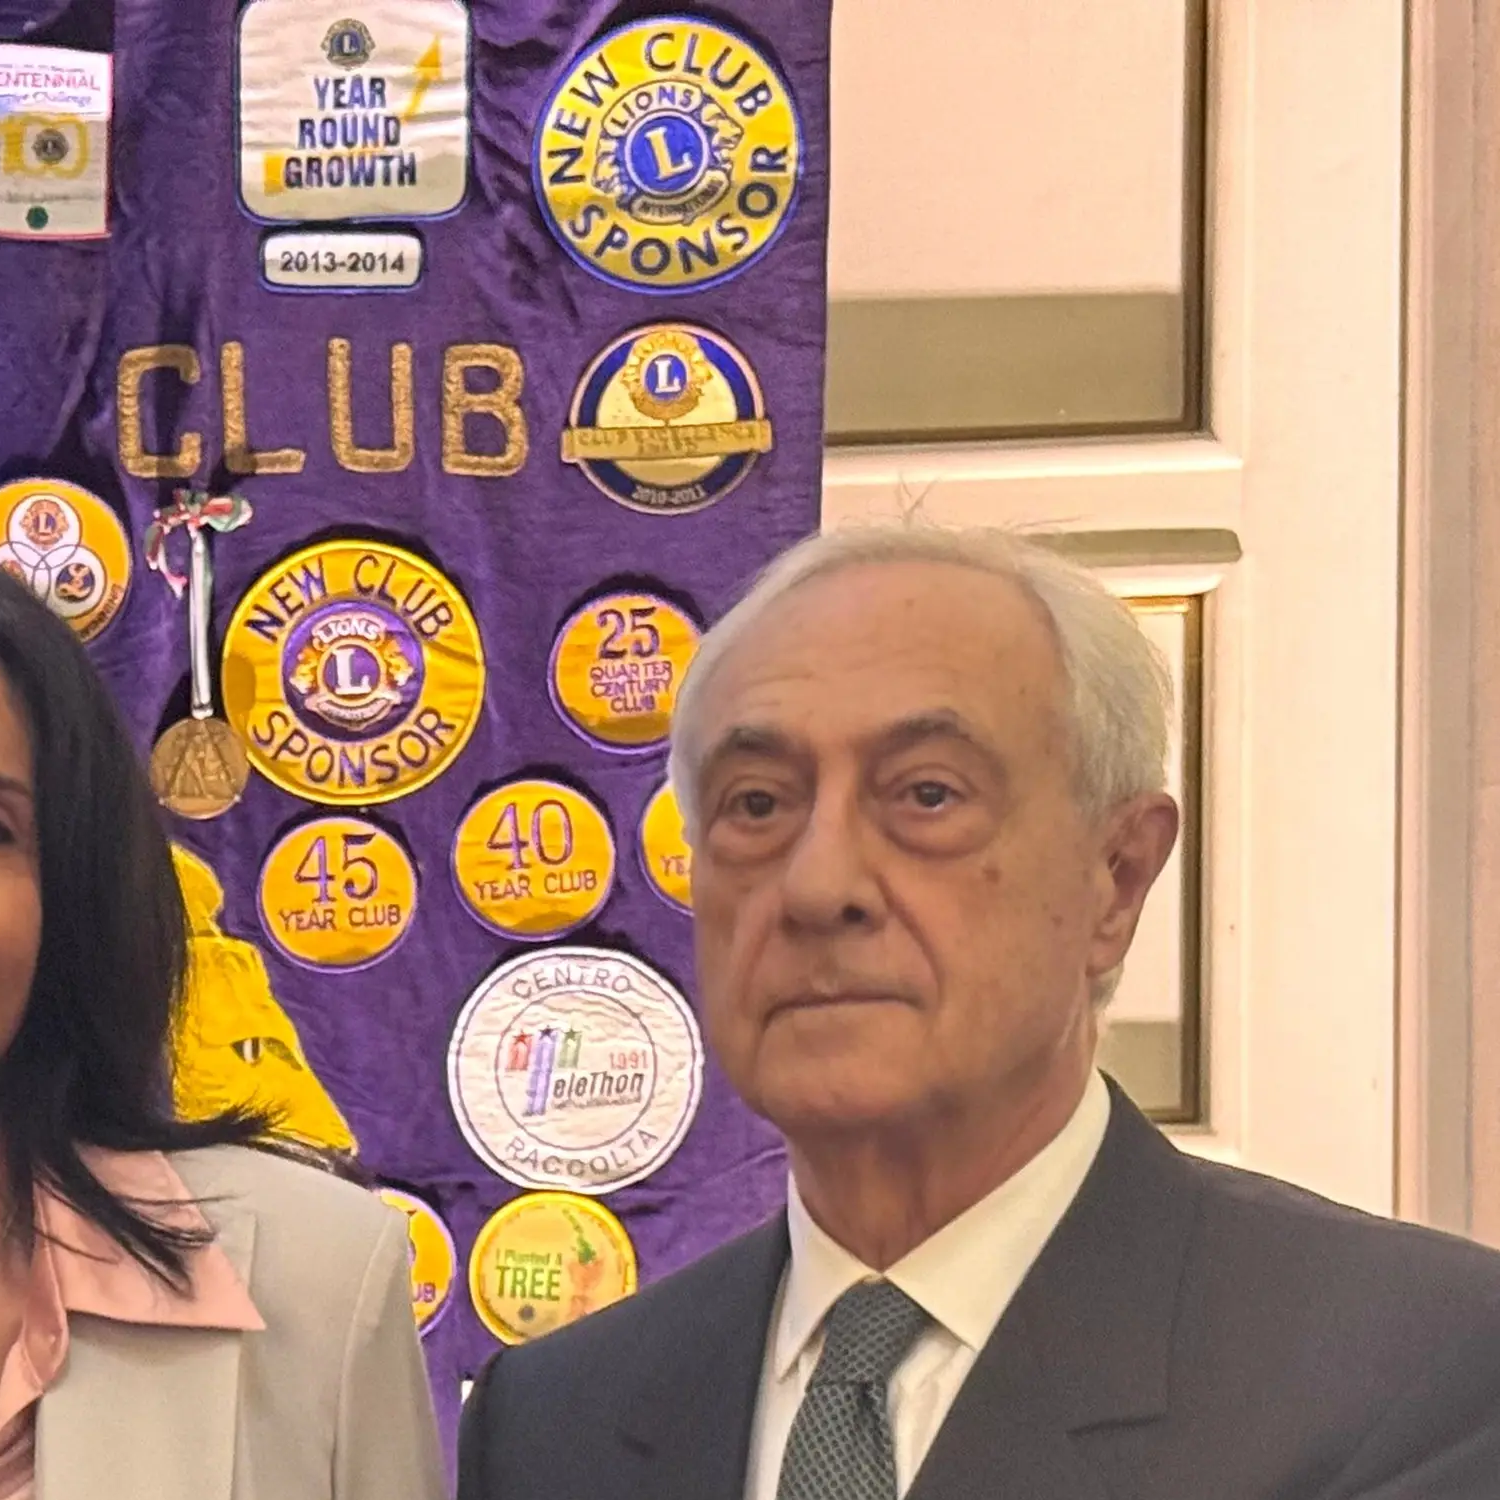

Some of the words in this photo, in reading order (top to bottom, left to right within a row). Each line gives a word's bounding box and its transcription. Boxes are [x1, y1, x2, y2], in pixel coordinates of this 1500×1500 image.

[314, 75, 386, 110] YEAR
[547, 52, 620, 186] NEW
[644, 32, 773, 117] CLUB
[611, 86, 694, 132] LIONS
[298, 113, 401, 150] ROUND
[285, 153, 417, 188] GROWTH
[645, 126, 694, 180] L
[568, 144, 789, 276] SPONSOR
[280, 251, 405, 273] 2013-2014
[655, 360, 681, 393] L
[117, 338, 529, 479] CLUB
[244, 556, 328, 643] NEW
[353, 554, 453, 637] CLUB
[316, 617, 380, 643] LIONS
[597, 607, 660, 660] 25
[331, 649, 371, 695] L
[590, 661, 673, 681] QUARTER
[591, 679, 672, 698] CENTURY
[611, 696, 655, 712] CLUB
[252, 707, 456, 787] SPONSOR
[486, 800, 574, 870] 40
[294, 833, 380, 904] 45
[473, 877, 532, 902] YEAR
[544, 870, 598, 894] CLUB
[278, 909, 337, 932] YEAR
[348, 904, 401, 926] CLUB
[512, 965, 633, 999] CENTRO
[609, 1050, 649, 1070] 1991
[505, 1127, 659, 1178] RACCOLTA
[496, 1266, 561, 1301] TREE
